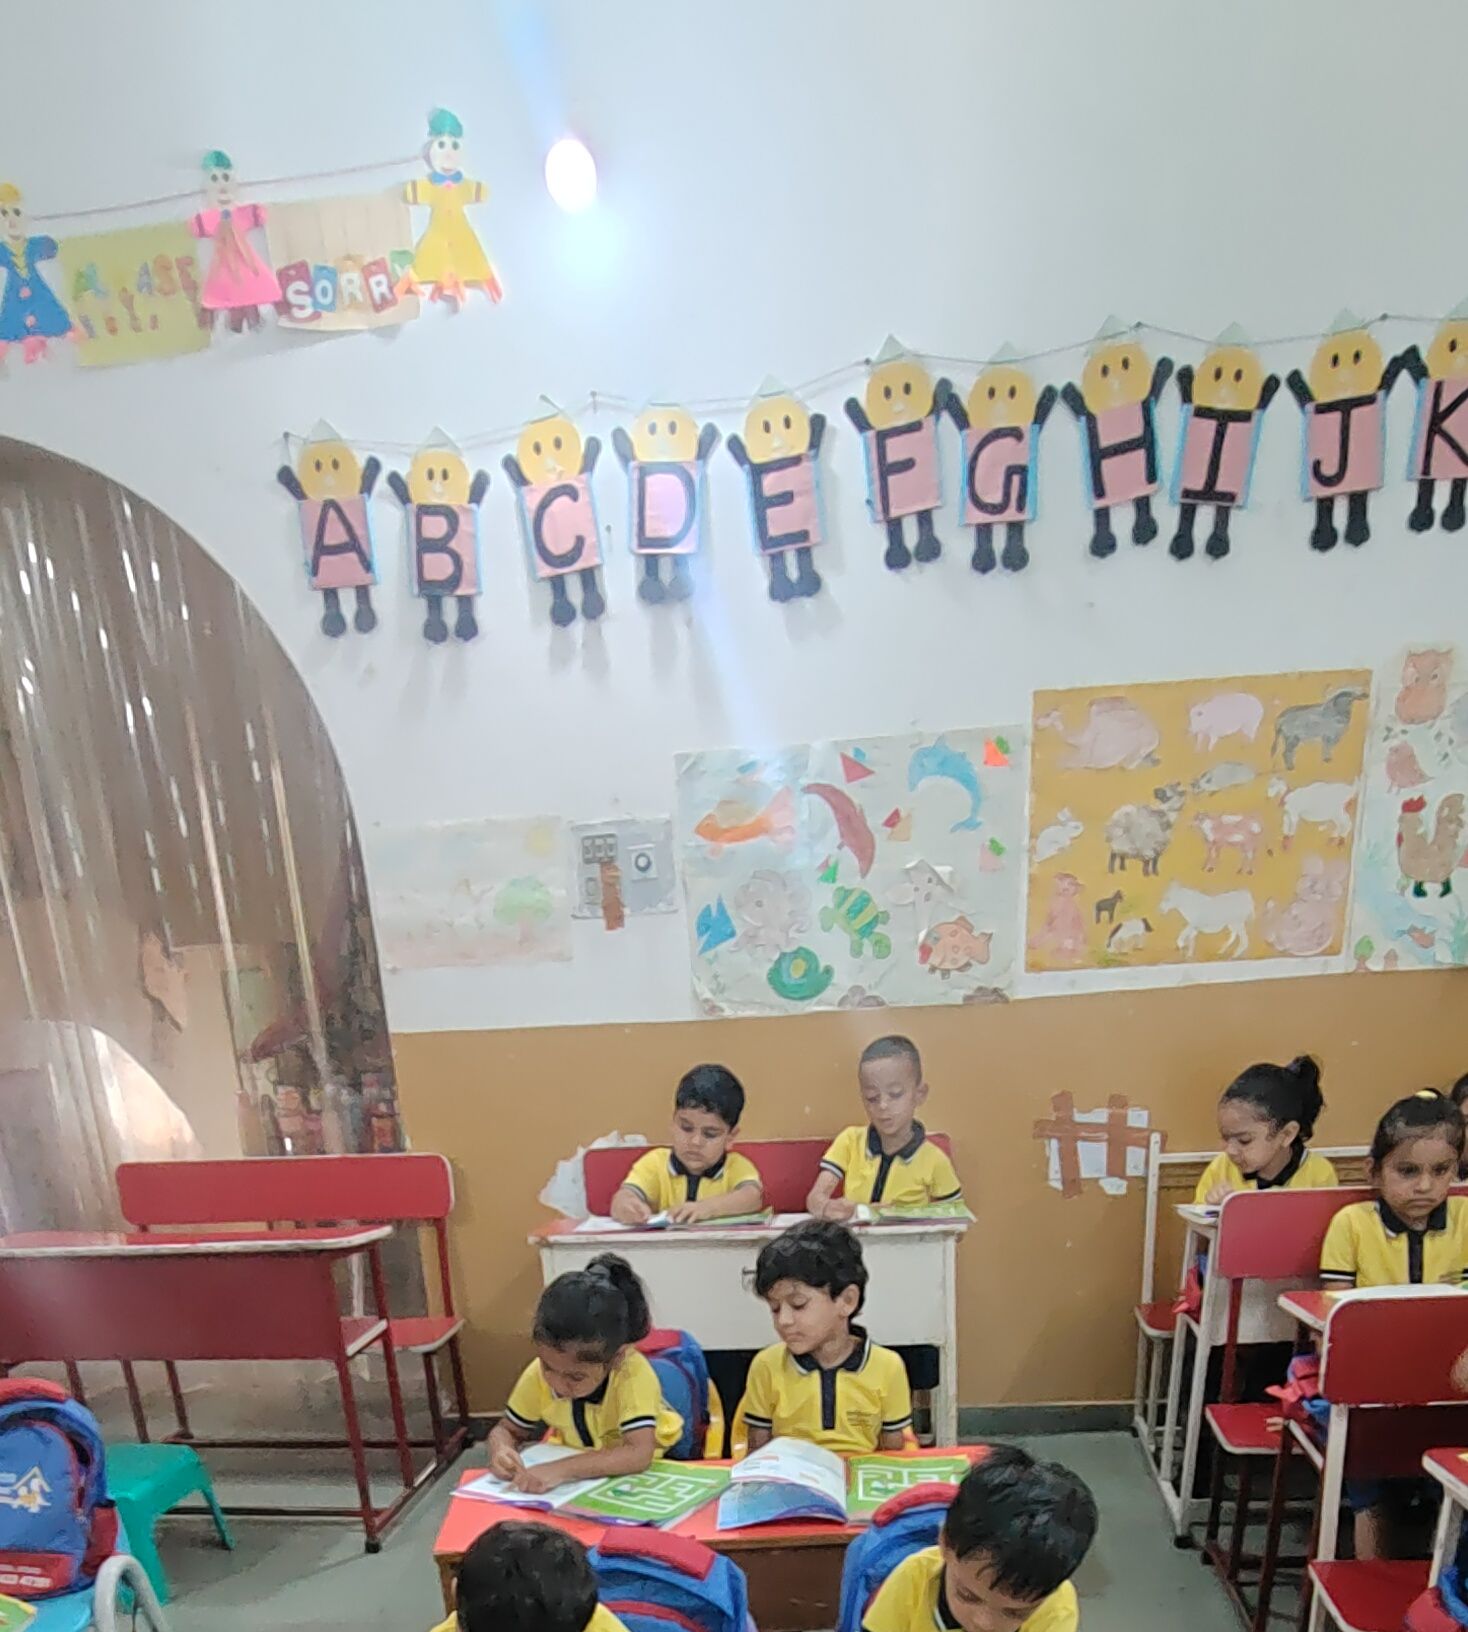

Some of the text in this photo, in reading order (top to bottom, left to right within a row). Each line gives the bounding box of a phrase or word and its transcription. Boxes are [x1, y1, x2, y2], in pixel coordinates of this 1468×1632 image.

[311, 380, 1468, 596] A B C D E F G H I J K
